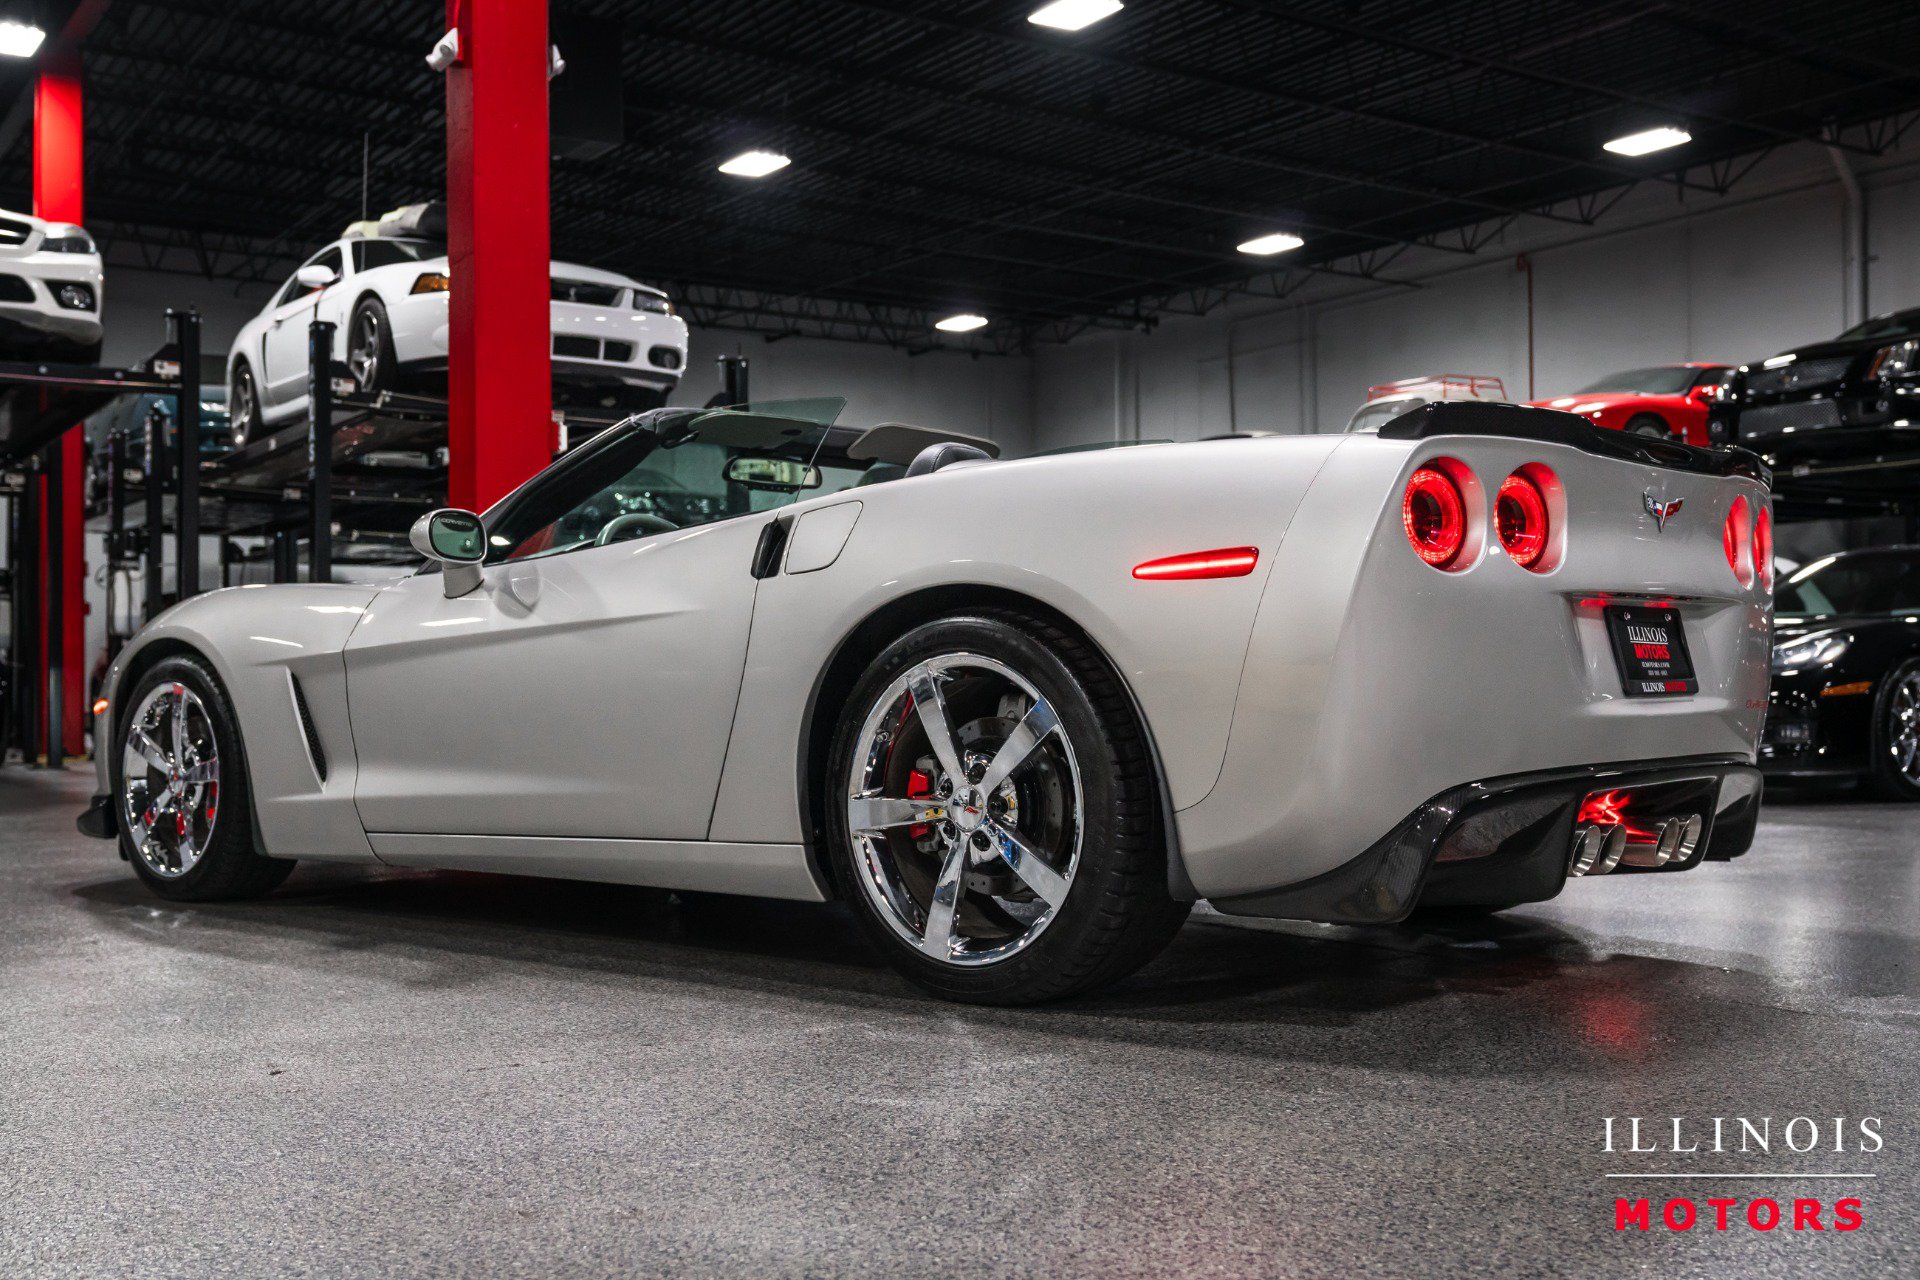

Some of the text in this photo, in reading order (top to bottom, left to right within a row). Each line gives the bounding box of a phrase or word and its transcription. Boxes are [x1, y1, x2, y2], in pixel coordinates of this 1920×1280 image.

[1627, 625, 1667, 642] ILLINOIS
[1634, 644, 1670, 659] MOTORS
[1641, 682, 1665, 692] ILLINOIS
